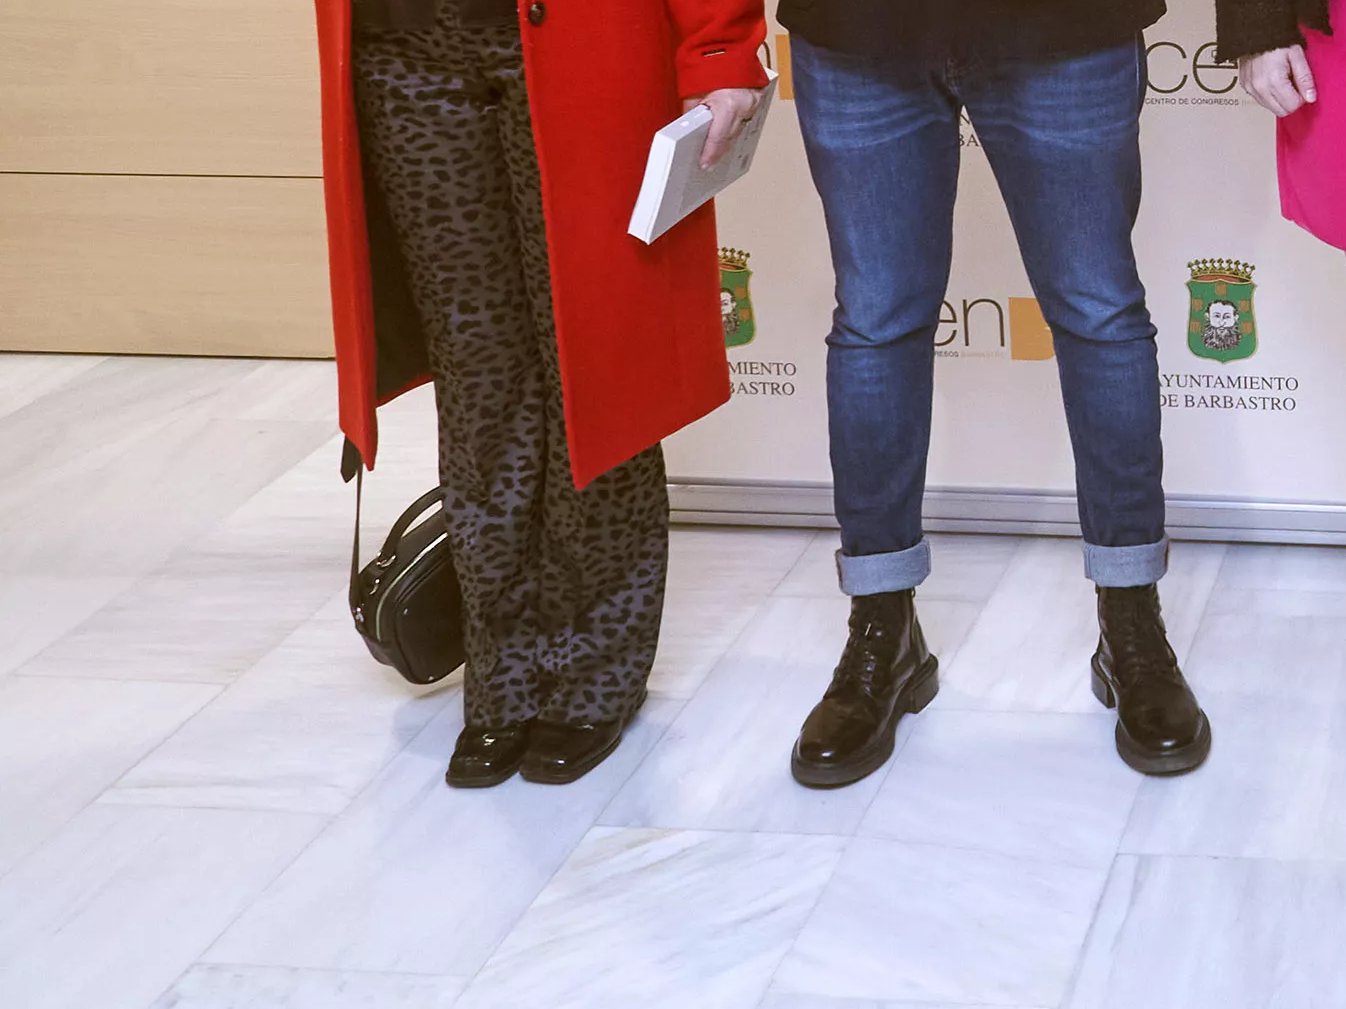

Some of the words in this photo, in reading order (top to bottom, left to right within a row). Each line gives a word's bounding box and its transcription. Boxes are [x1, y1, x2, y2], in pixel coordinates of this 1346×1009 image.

[1191, 98, 1240, 106] CONGRESOS
[727, 361, 797, 376] MIENTO
[729, 381, 796, 395] BASTRO
[1185, 394, 1297, 411] BARBASTRO
